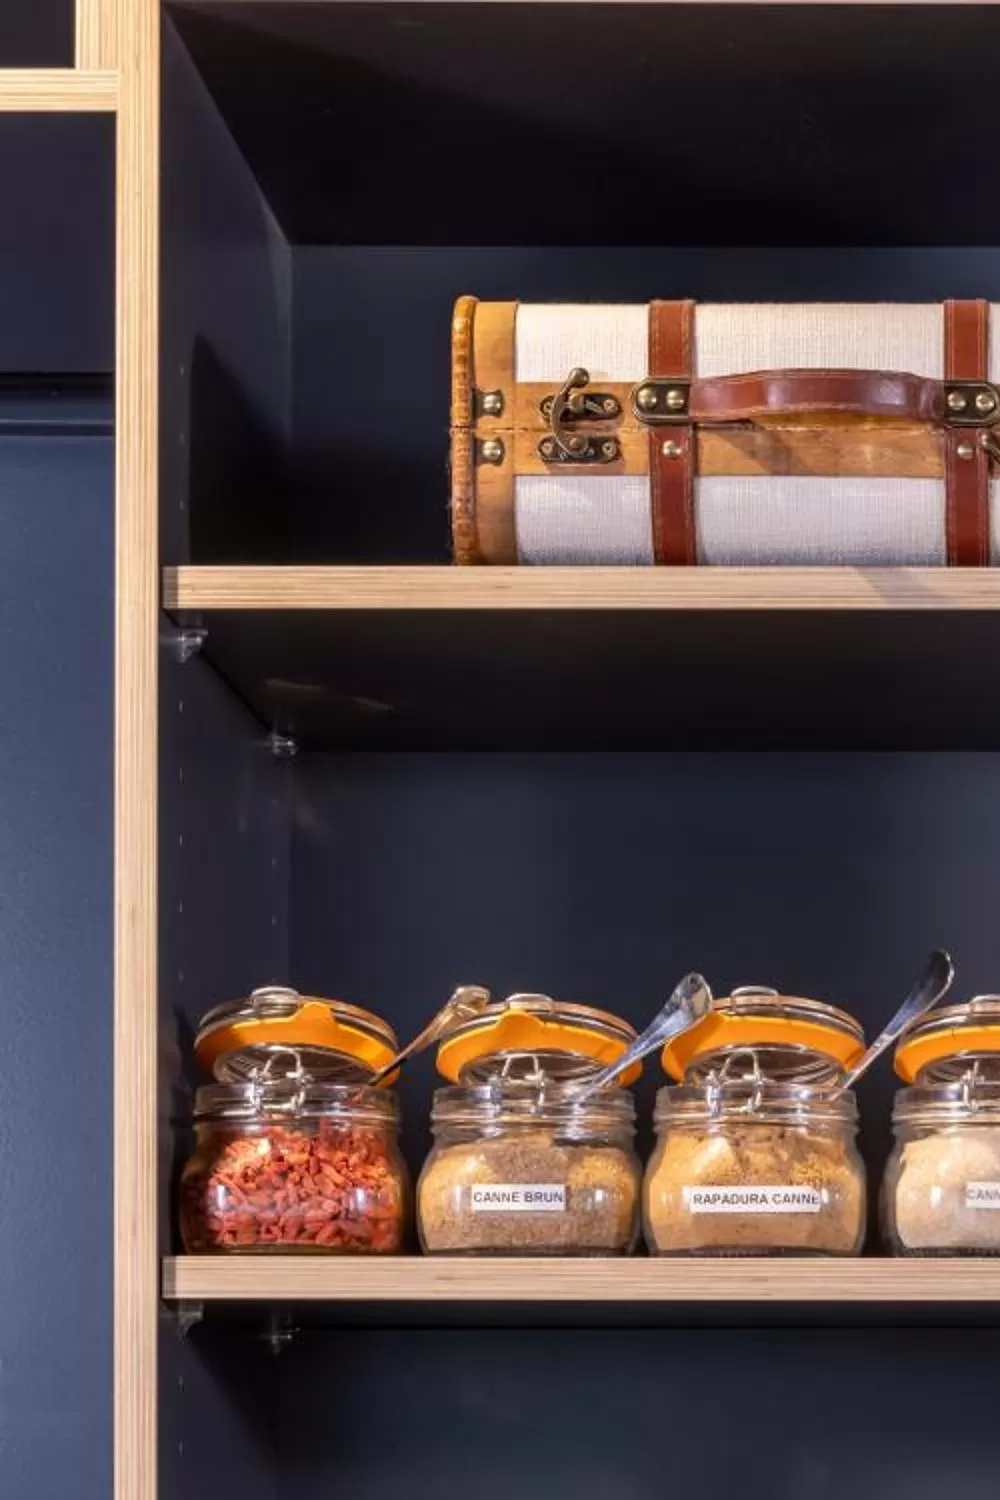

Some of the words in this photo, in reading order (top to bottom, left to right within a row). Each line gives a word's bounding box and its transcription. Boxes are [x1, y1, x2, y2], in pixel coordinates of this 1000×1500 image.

[473, 1191, 520, 1203] CANNE
[523, 1191, 563, 1203] BRUN
[693, 1193, 769, 1205] RAPADURA
[772, 1193, 820, 1205] CANNE
